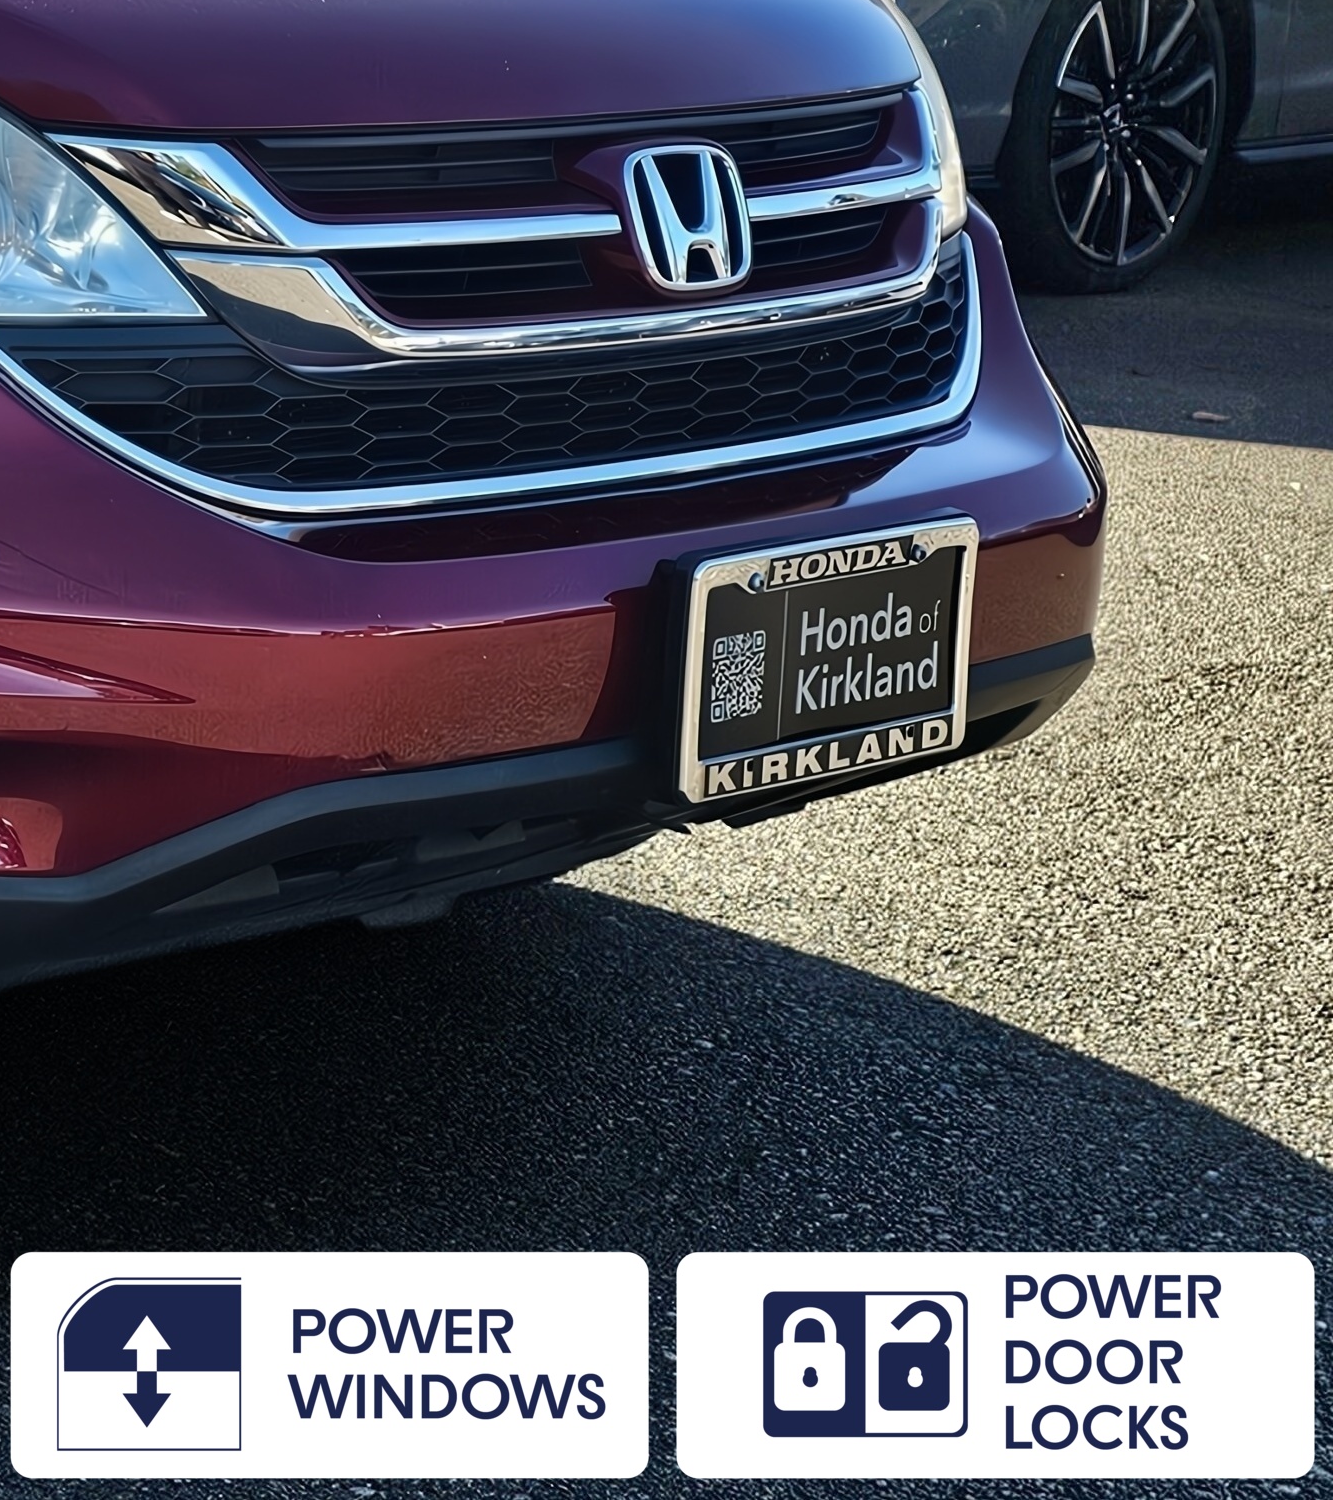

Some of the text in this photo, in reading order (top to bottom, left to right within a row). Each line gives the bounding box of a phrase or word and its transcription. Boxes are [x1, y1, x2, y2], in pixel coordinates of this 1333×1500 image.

[769, 541, 907, 587] HONDA
[800, 592, 941, 656] Honda of
[795, 641, 938, 714] Kirkland
[708, 719, 948, 795] KIRKLAND
